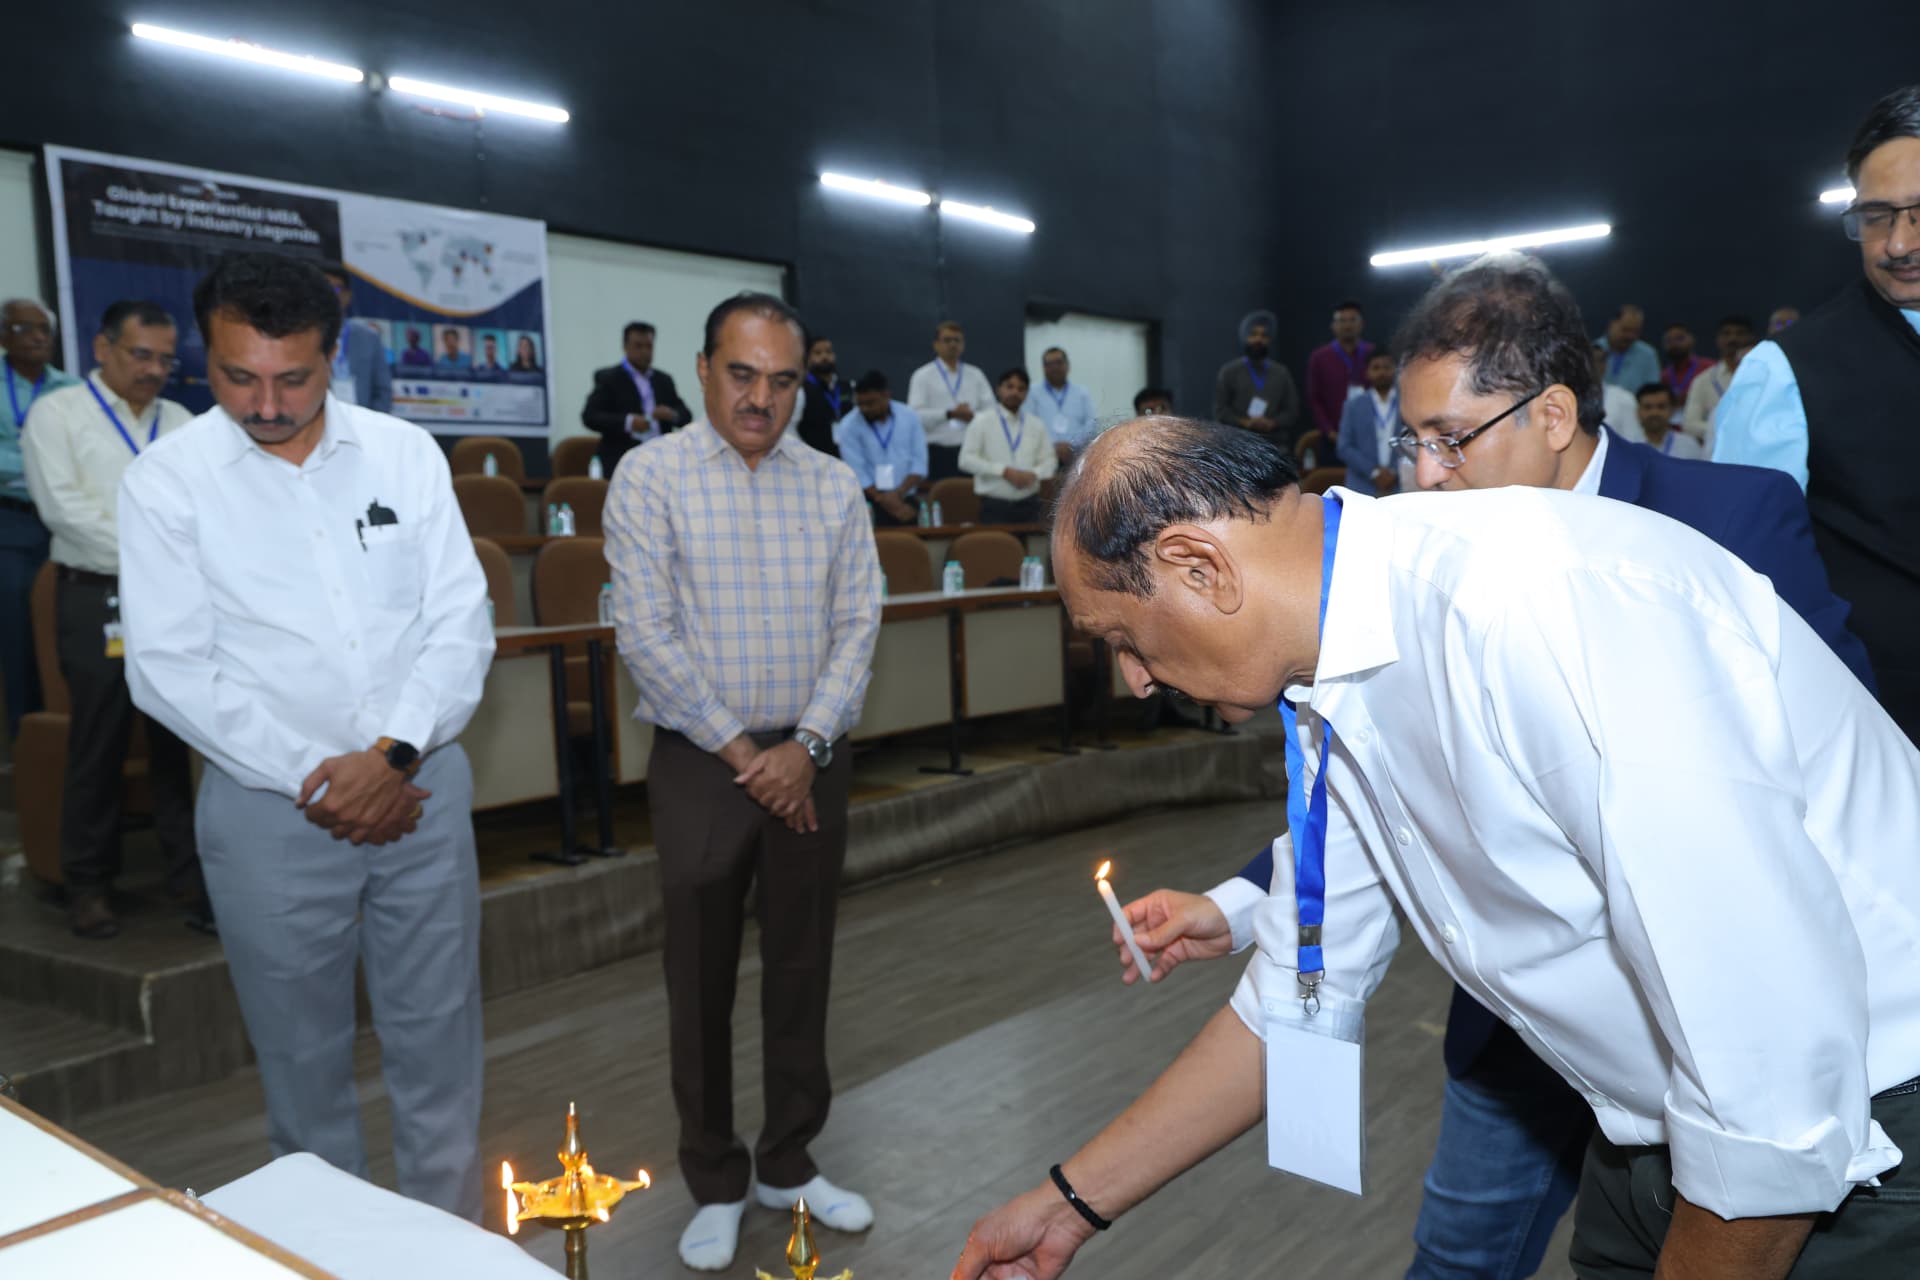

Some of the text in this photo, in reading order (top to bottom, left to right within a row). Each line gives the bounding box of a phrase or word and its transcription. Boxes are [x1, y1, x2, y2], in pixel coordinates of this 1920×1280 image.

[91, 199, 158, 225] Taught
[160, 207, 184, 229] by
[187, 212, 255, 239] Industry
[256, 225, 320, 245] Legends
[105, 185, 166, 207] Global
[168, 193, 263, 220] Experiential
